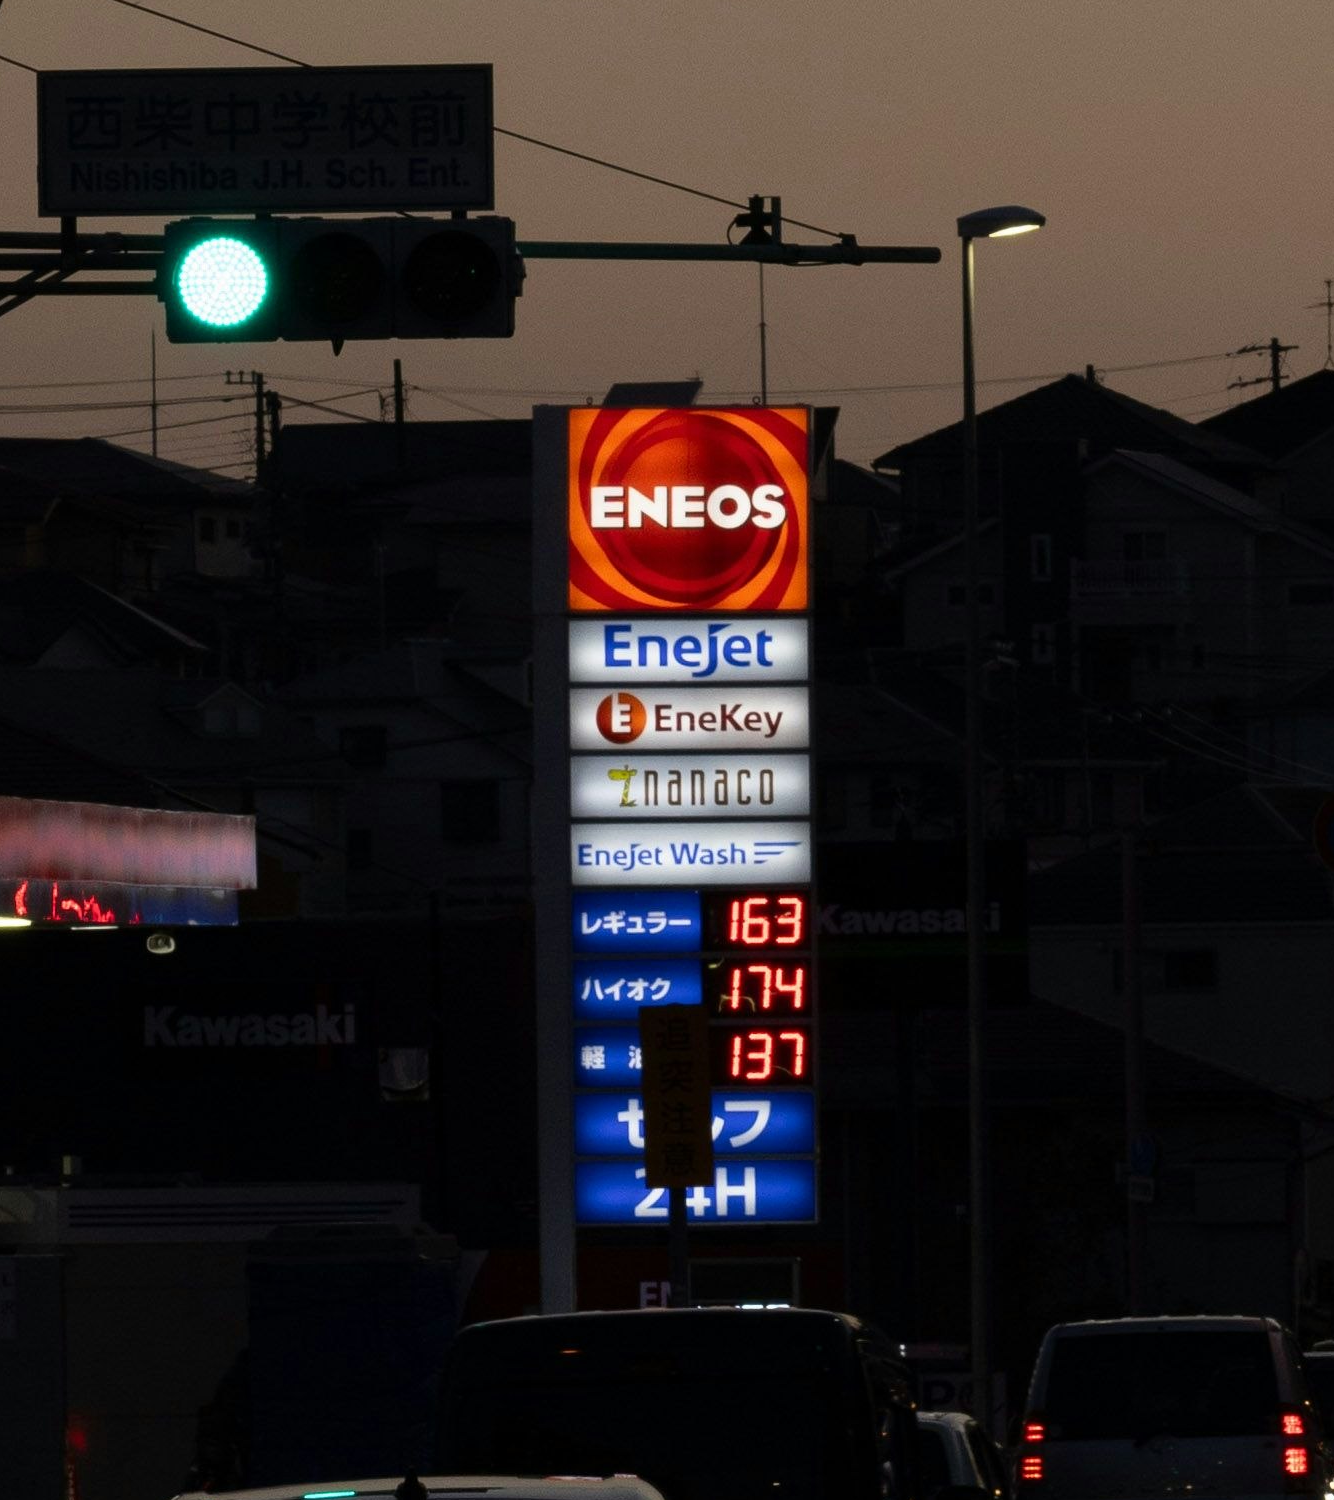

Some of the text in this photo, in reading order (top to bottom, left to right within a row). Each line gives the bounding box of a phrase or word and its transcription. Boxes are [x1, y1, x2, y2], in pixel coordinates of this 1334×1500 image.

[68, 90, 467, 152] 西柴中学校前
[71, 157, 471, 195] Nishishiba J.H. Sch. Ent.
[590, 483, 787, 530] ENEOS
[654, 703, 784, 739] EneKey
[643, 767, 775, 807] nanaco
[669, 841, 748, 867] Wash
[581, 898, 802, 945] レギュラー 163
[816, 900, 1002, 936] Kawasai
[581, 965, 804, 1009] ハイオク 174
[143, 1002, 355, 1048] Kawasaki
[731, 1033, 804, 1080] 137
[655, 1017, 696, 1178] 追突注意
[617, 1098, 771, 1149] セフ
